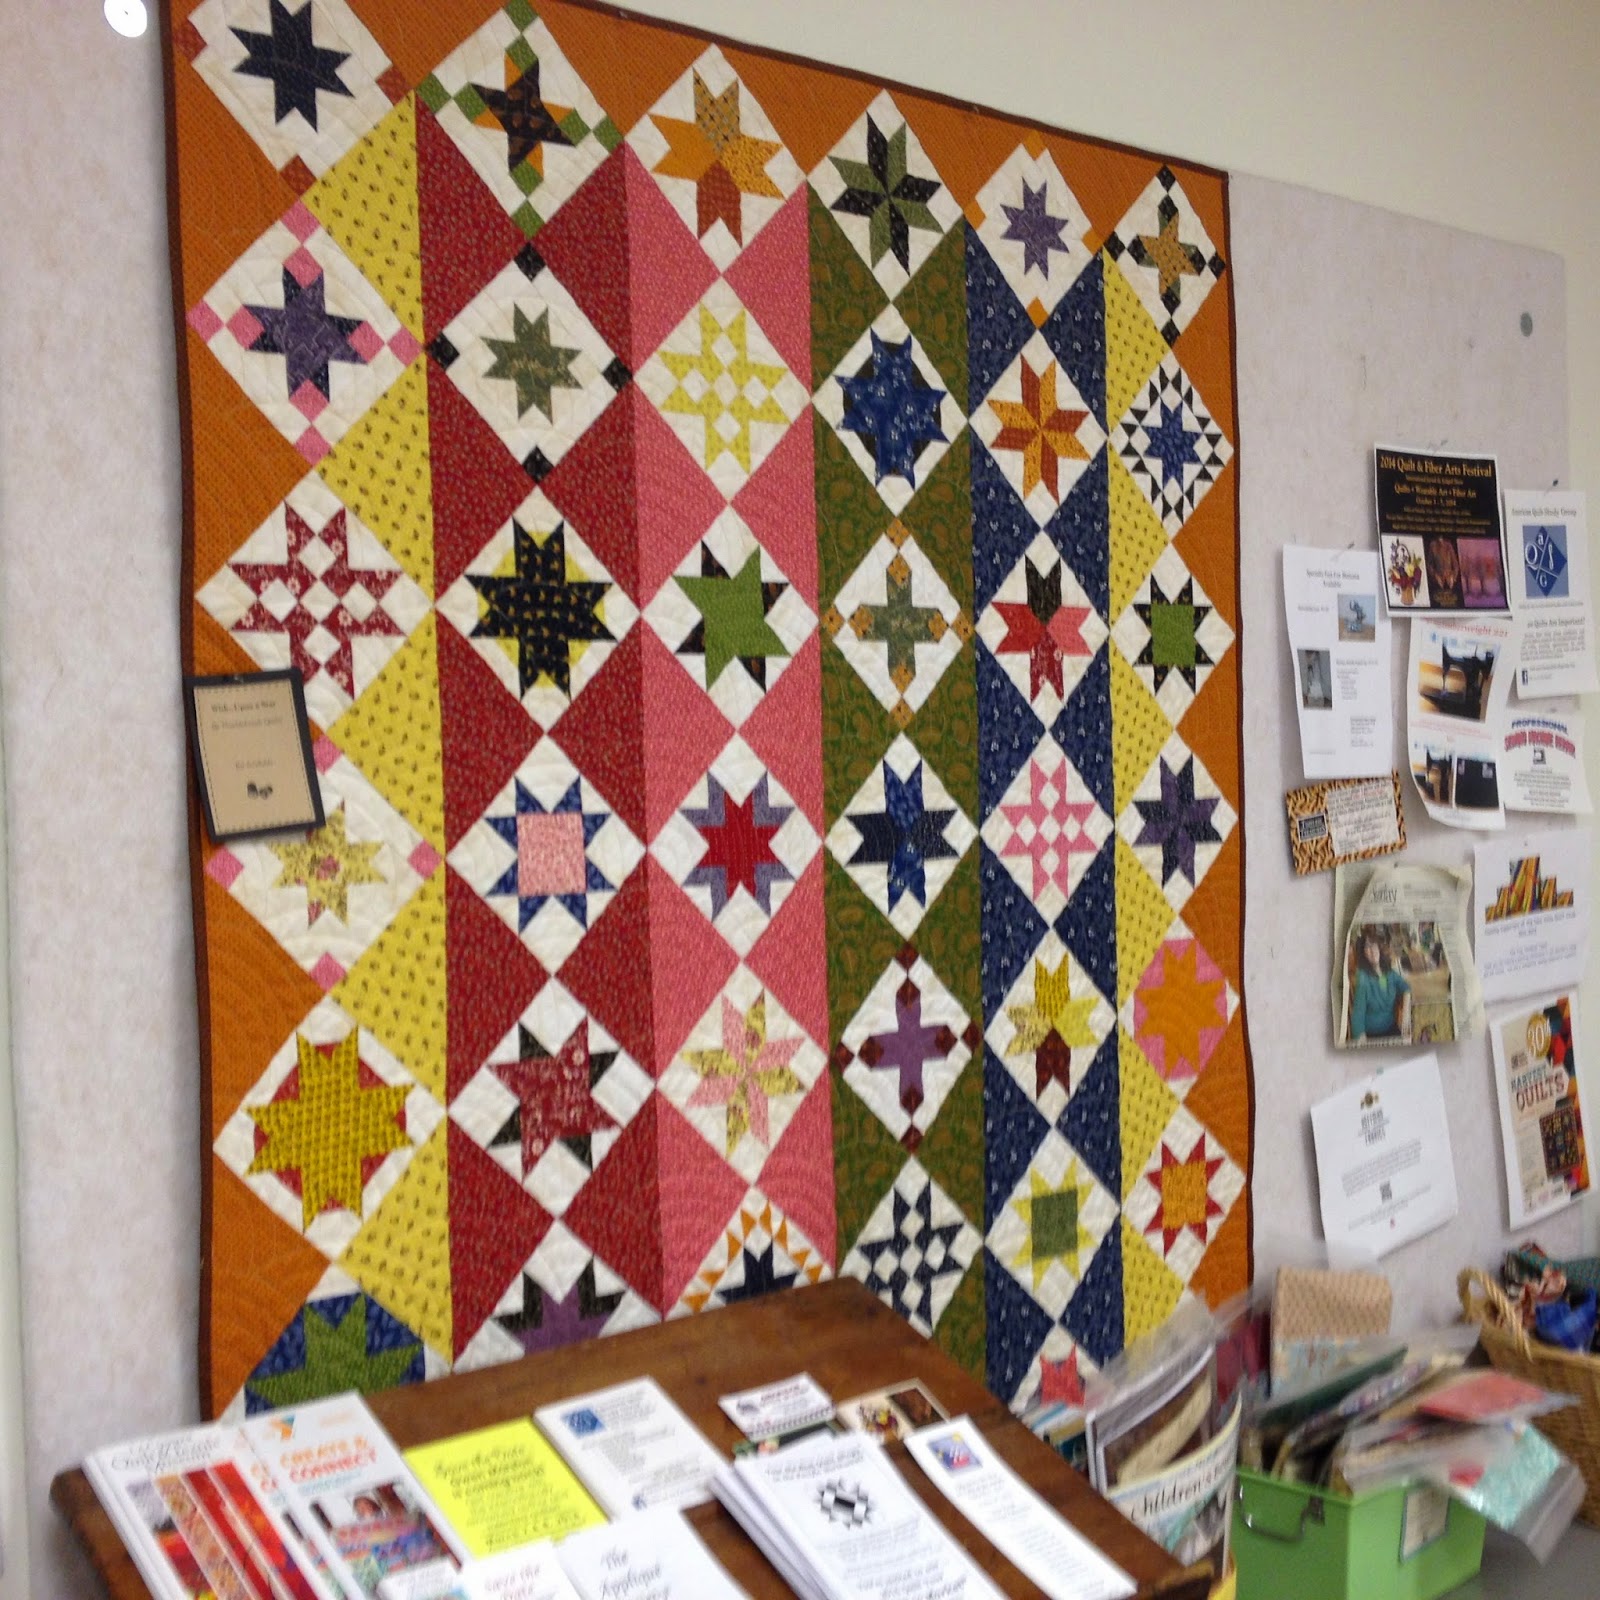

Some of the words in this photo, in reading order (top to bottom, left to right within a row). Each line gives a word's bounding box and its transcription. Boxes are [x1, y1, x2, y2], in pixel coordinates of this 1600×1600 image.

[1397, 458, 1415, 473] Quilt
[1424, 460, 1443, 474] Fiber
[1445, 463, 1461, 476] Arts
[1462, 463, 1492, 477] Festival
[1516, 1071, 1565, 1112] QUILTS
